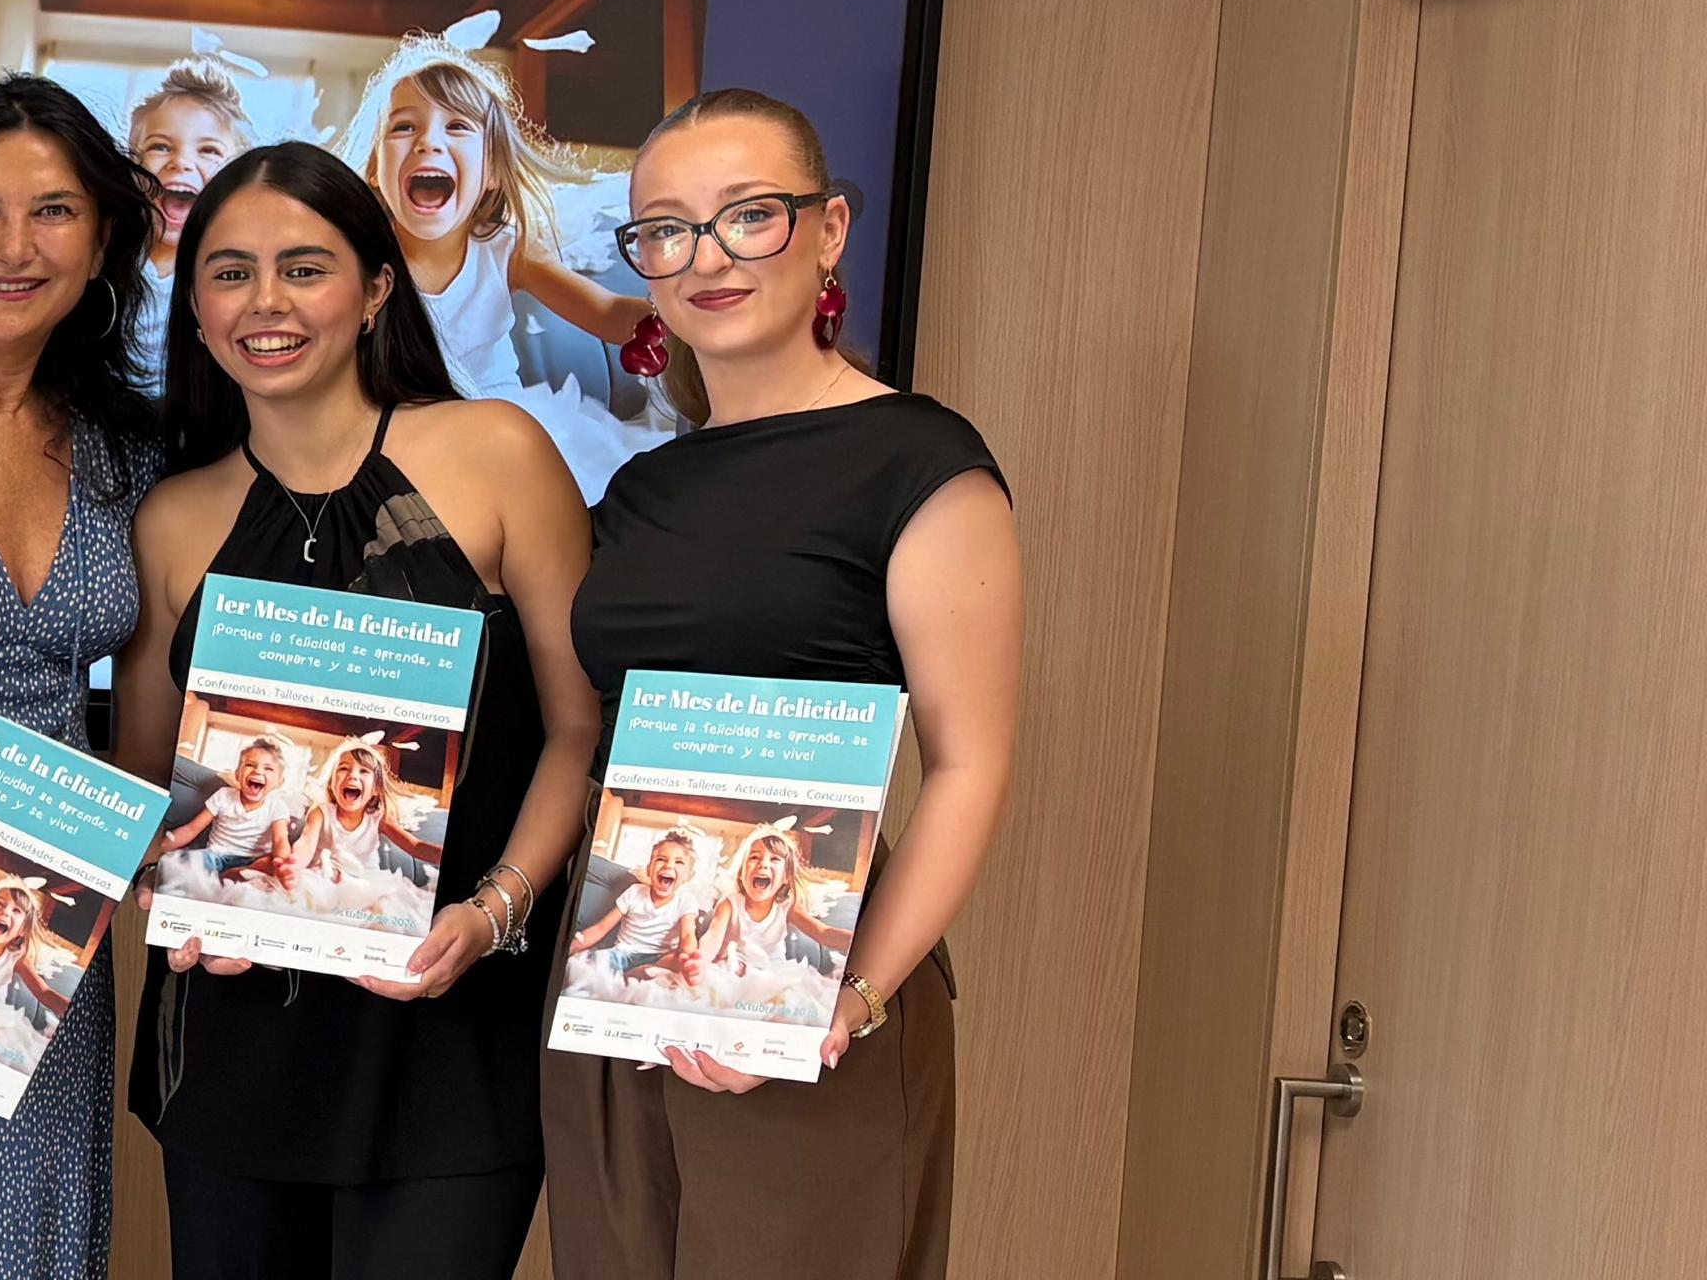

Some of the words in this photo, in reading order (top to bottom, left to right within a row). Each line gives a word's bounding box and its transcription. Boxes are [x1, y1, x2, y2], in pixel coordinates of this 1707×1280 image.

[253, 599, 299, 623] Mes
[300, 605, 330, 628] de
[333, 609, 356, 632] la
[358, 613, 461, 648] felicidad
[669, 689, 713, 712] Mes
[715, 692, 744, 714] de
[747, 693, 769, 716] la
[772, 696, 876, 723] felicidad
[0, 743, 28, 767] de
[28, 753, 50, 779] la
[50, 765, 146, 822] felicidad
